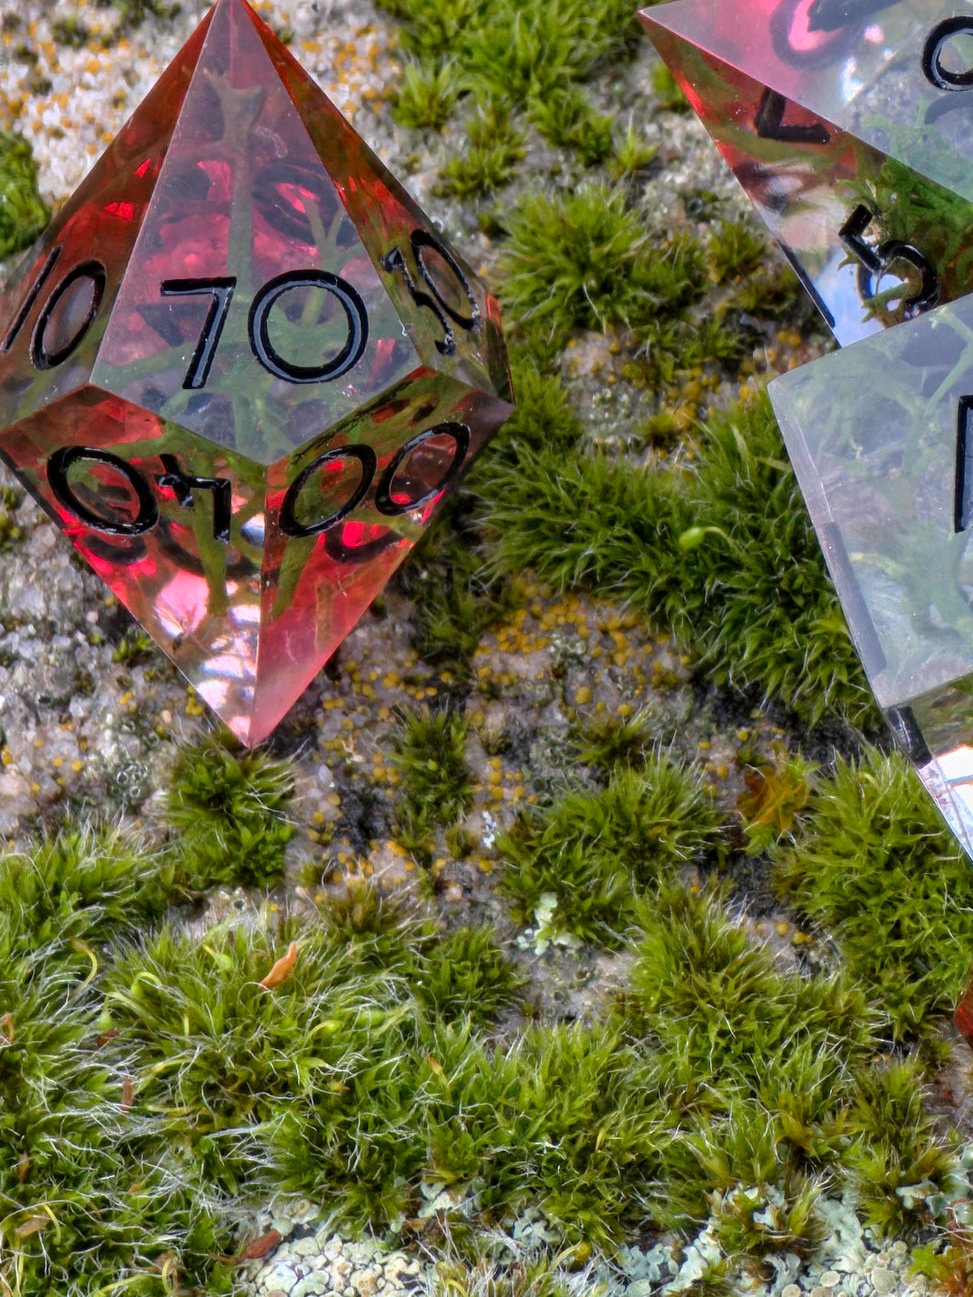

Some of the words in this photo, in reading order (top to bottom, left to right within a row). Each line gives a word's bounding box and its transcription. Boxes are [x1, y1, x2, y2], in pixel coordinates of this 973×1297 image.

[0, 244, 107, 371] 10
[160, 268, 370, 390] 70
[278, 421, 471, 538] 00
